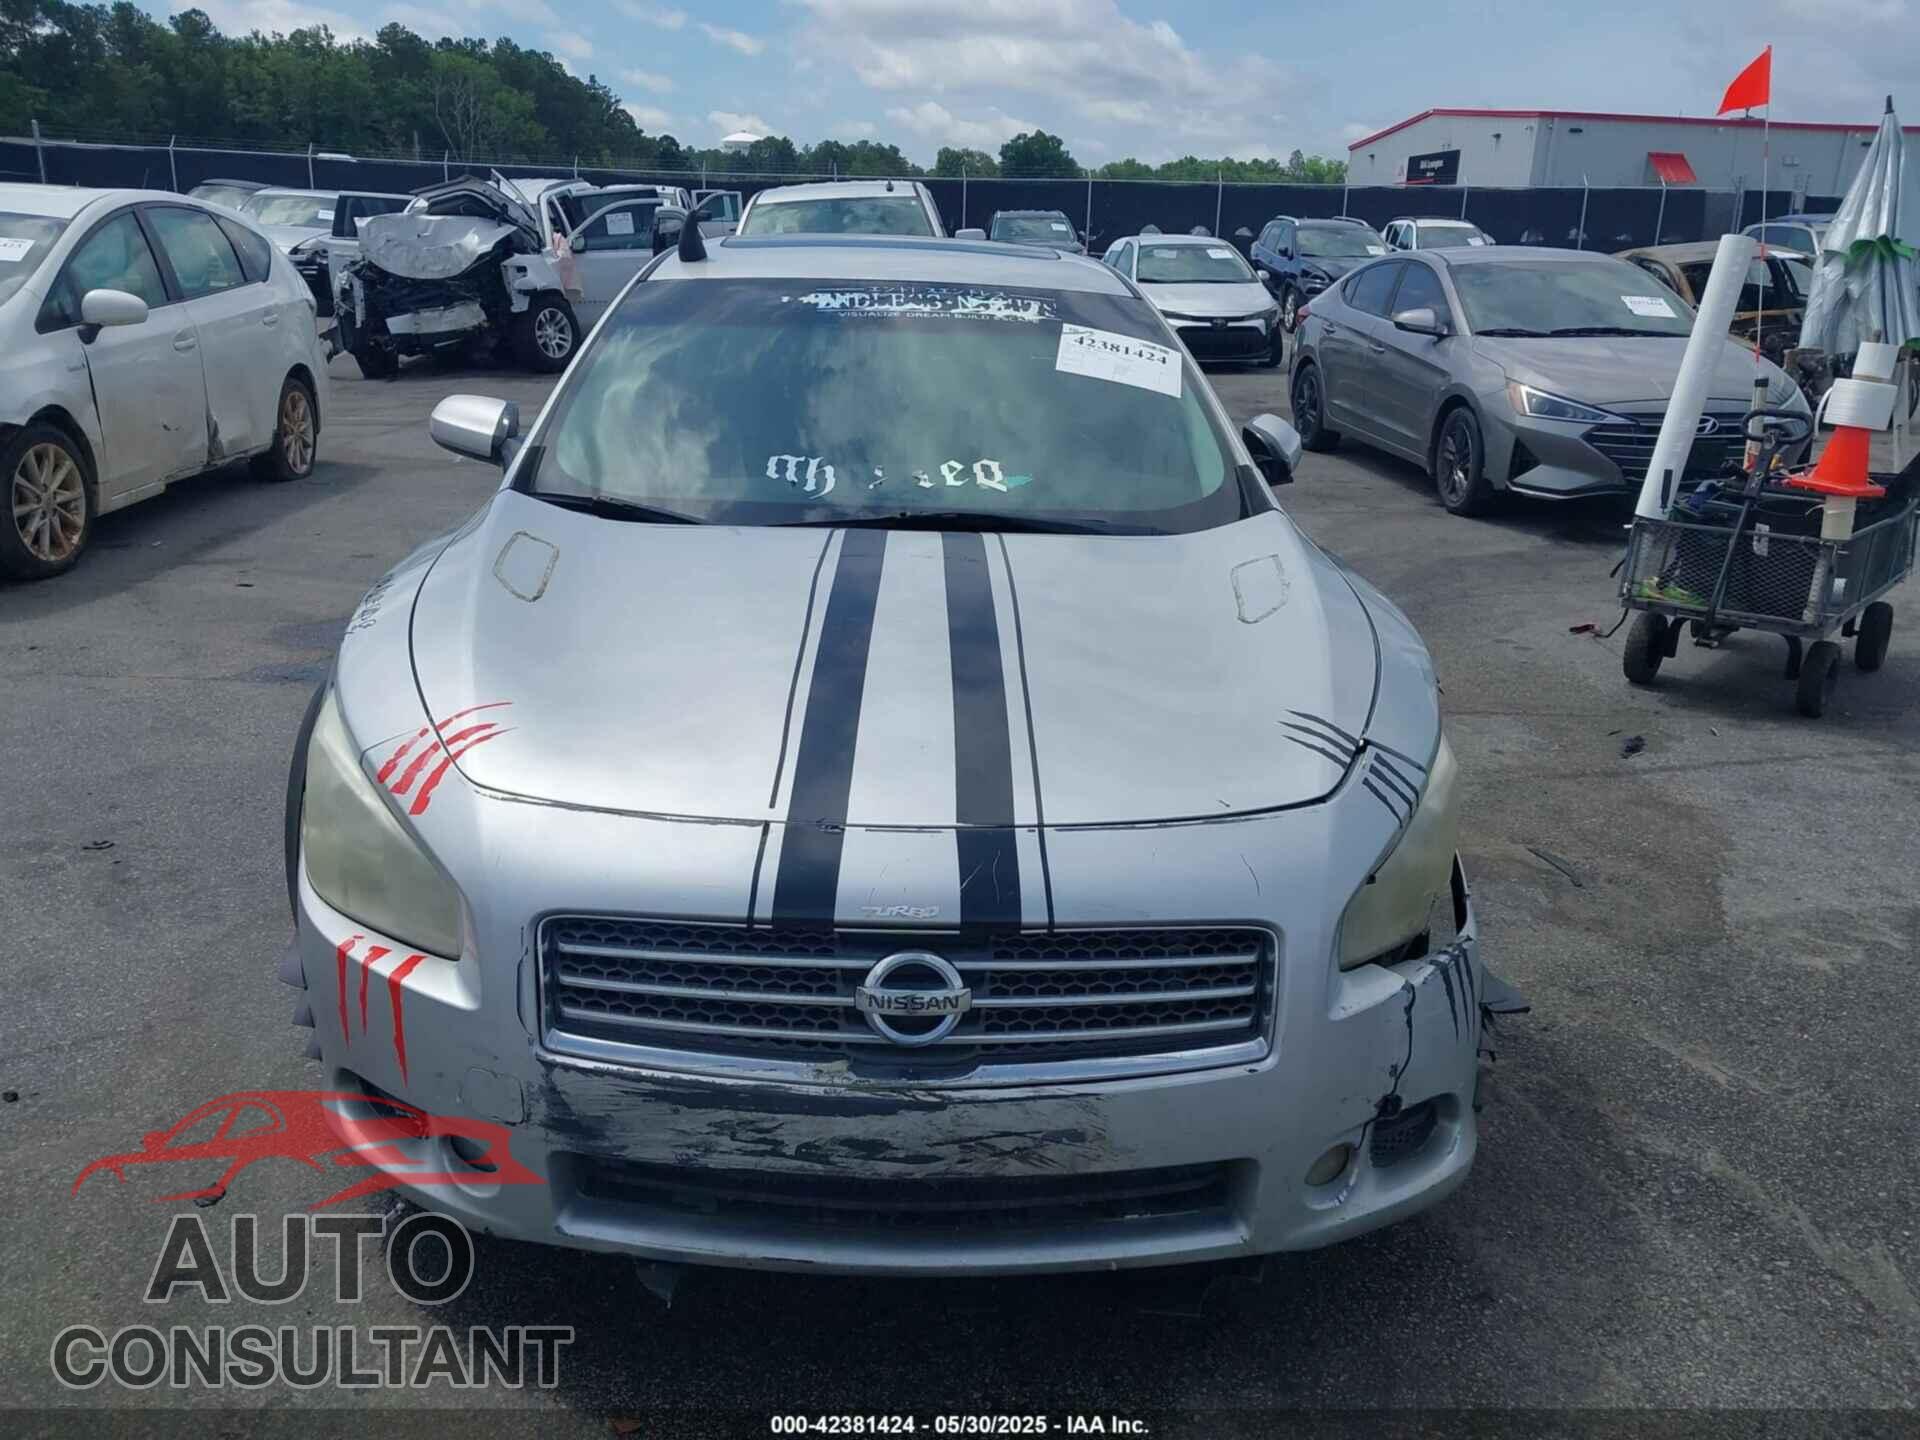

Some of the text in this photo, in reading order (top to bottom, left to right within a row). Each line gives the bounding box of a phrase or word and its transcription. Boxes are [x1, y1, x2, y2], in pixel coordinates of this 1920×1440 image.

[1074, 335, 1167, 365] 42381424
[861, 904, 940, 920] TURBO
[867, 994, 959, 1010] NISSAN
